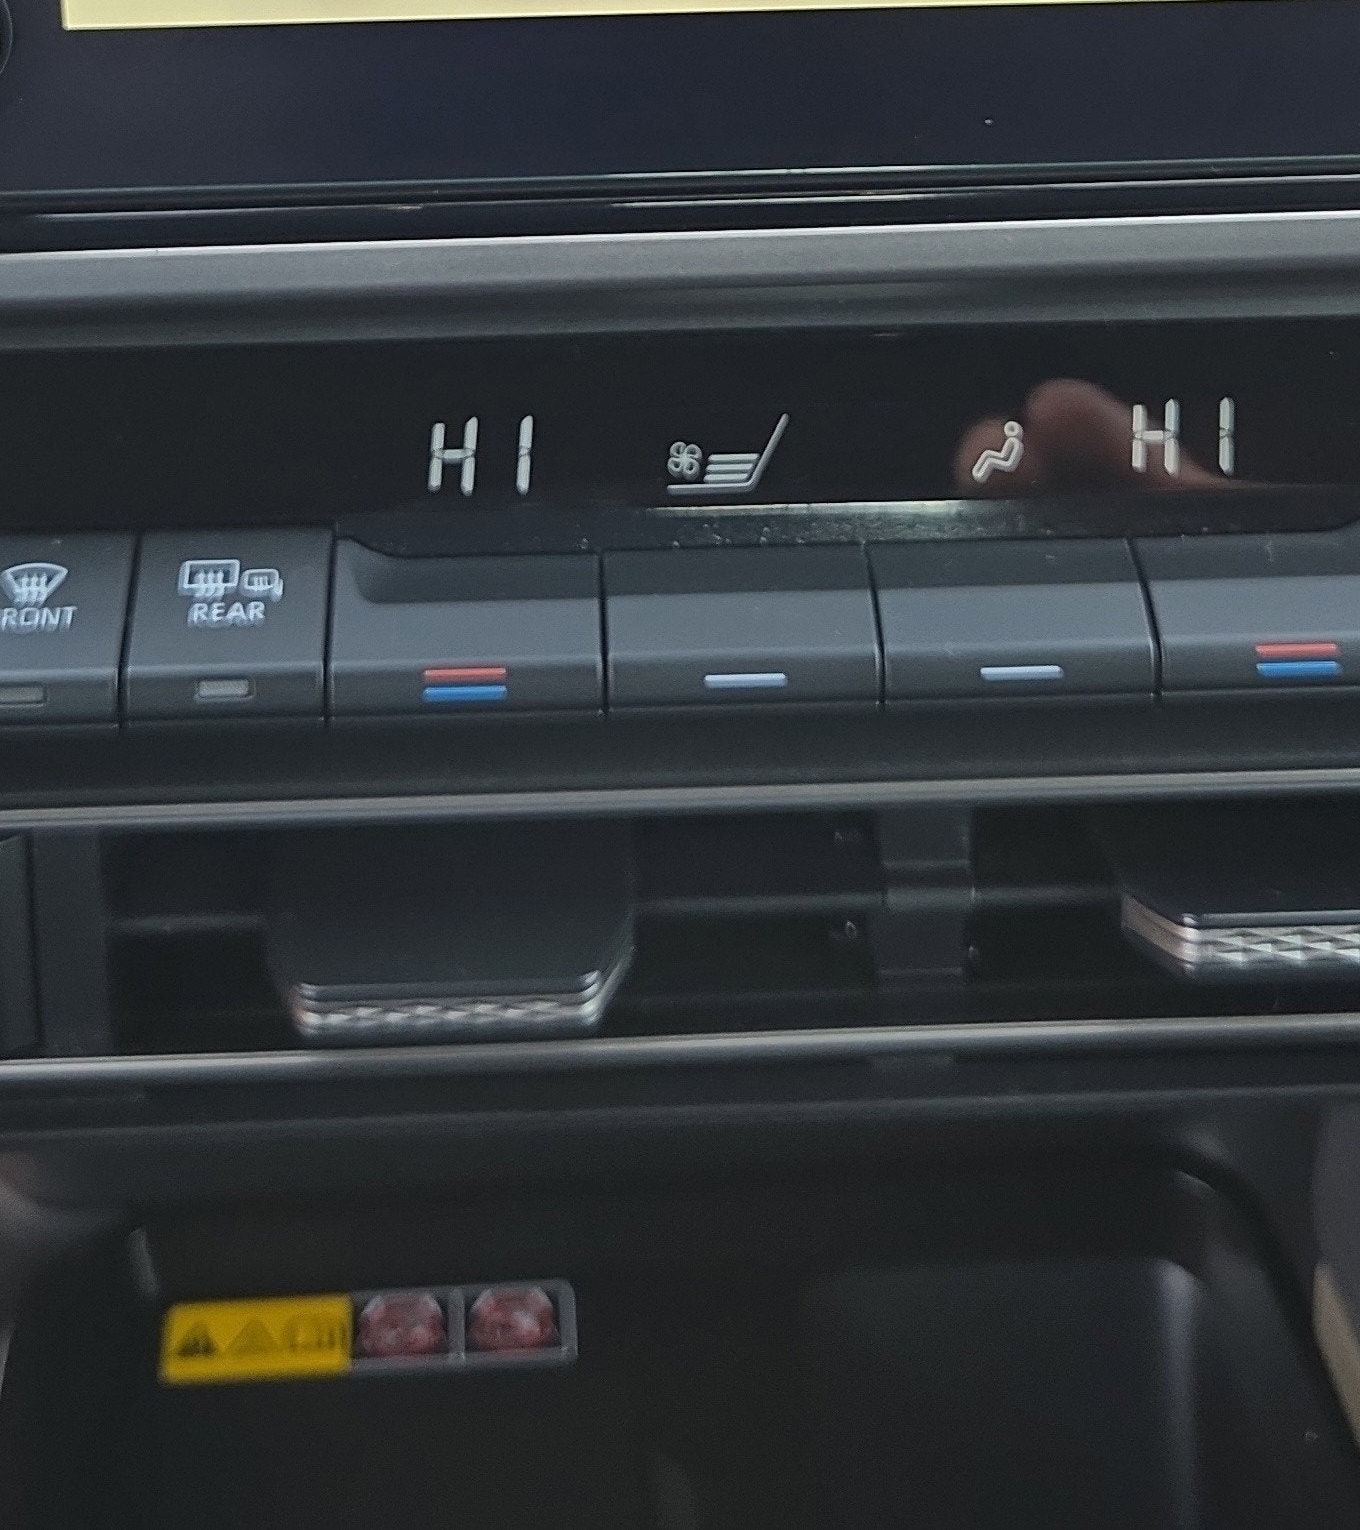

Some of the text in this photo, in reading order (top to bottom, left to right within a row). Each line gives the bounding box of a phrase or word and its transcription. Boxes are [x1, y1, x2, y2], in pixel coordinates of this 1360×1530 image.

[428, 415, 534, 495] HI
[1131, 397, 1236, 476] HI
[190, 601, 270, 627] REAR
